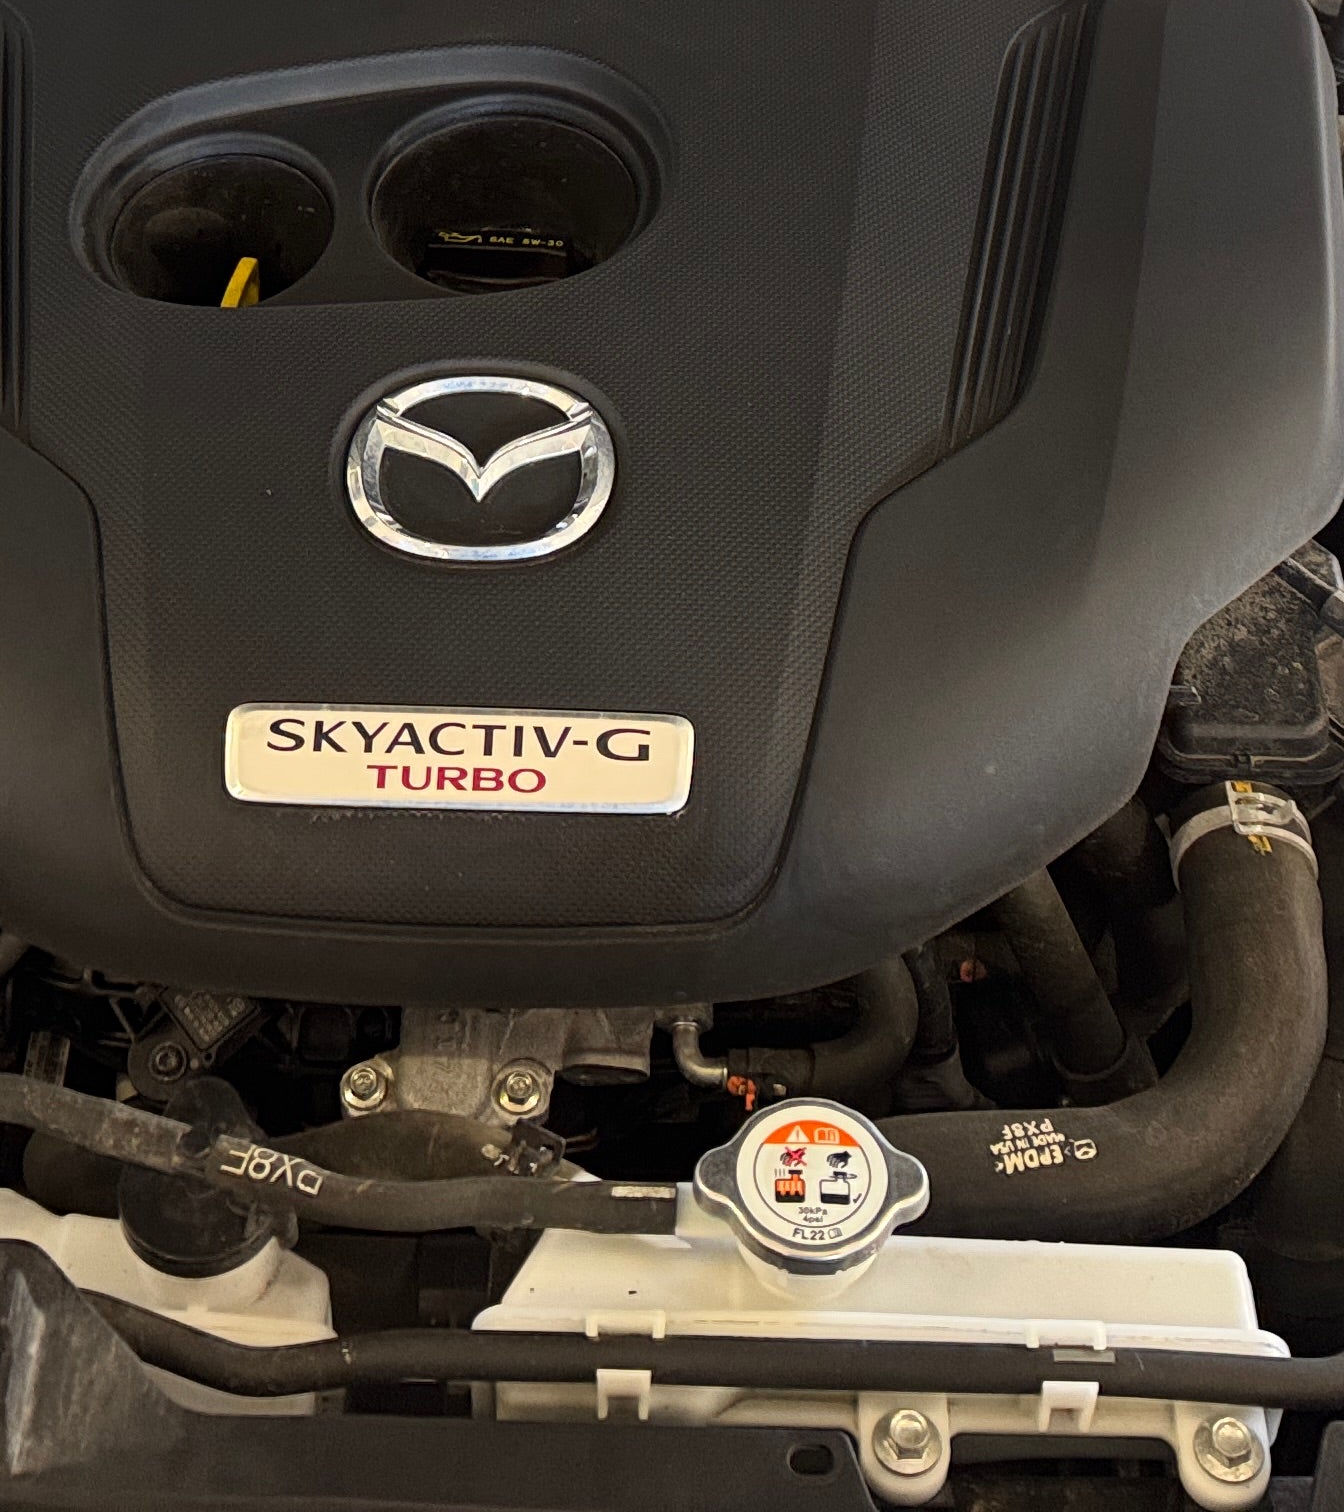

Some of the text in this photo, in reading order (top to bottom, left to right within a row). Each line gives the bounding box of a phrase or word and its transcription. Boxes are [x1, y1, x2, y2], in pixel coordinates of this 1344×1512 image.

[488, 235, 564, 247] SAE 5W-30
[265, 717, 652, 762] SKYACTIV-G
[366, 764, 547, 794] TURBO
[1001, 1118, 1054, 1140] PX8F
[989, 1133, 1065, 1155] MADE IN USA
[792, 1227, 826, 1242] FL22
